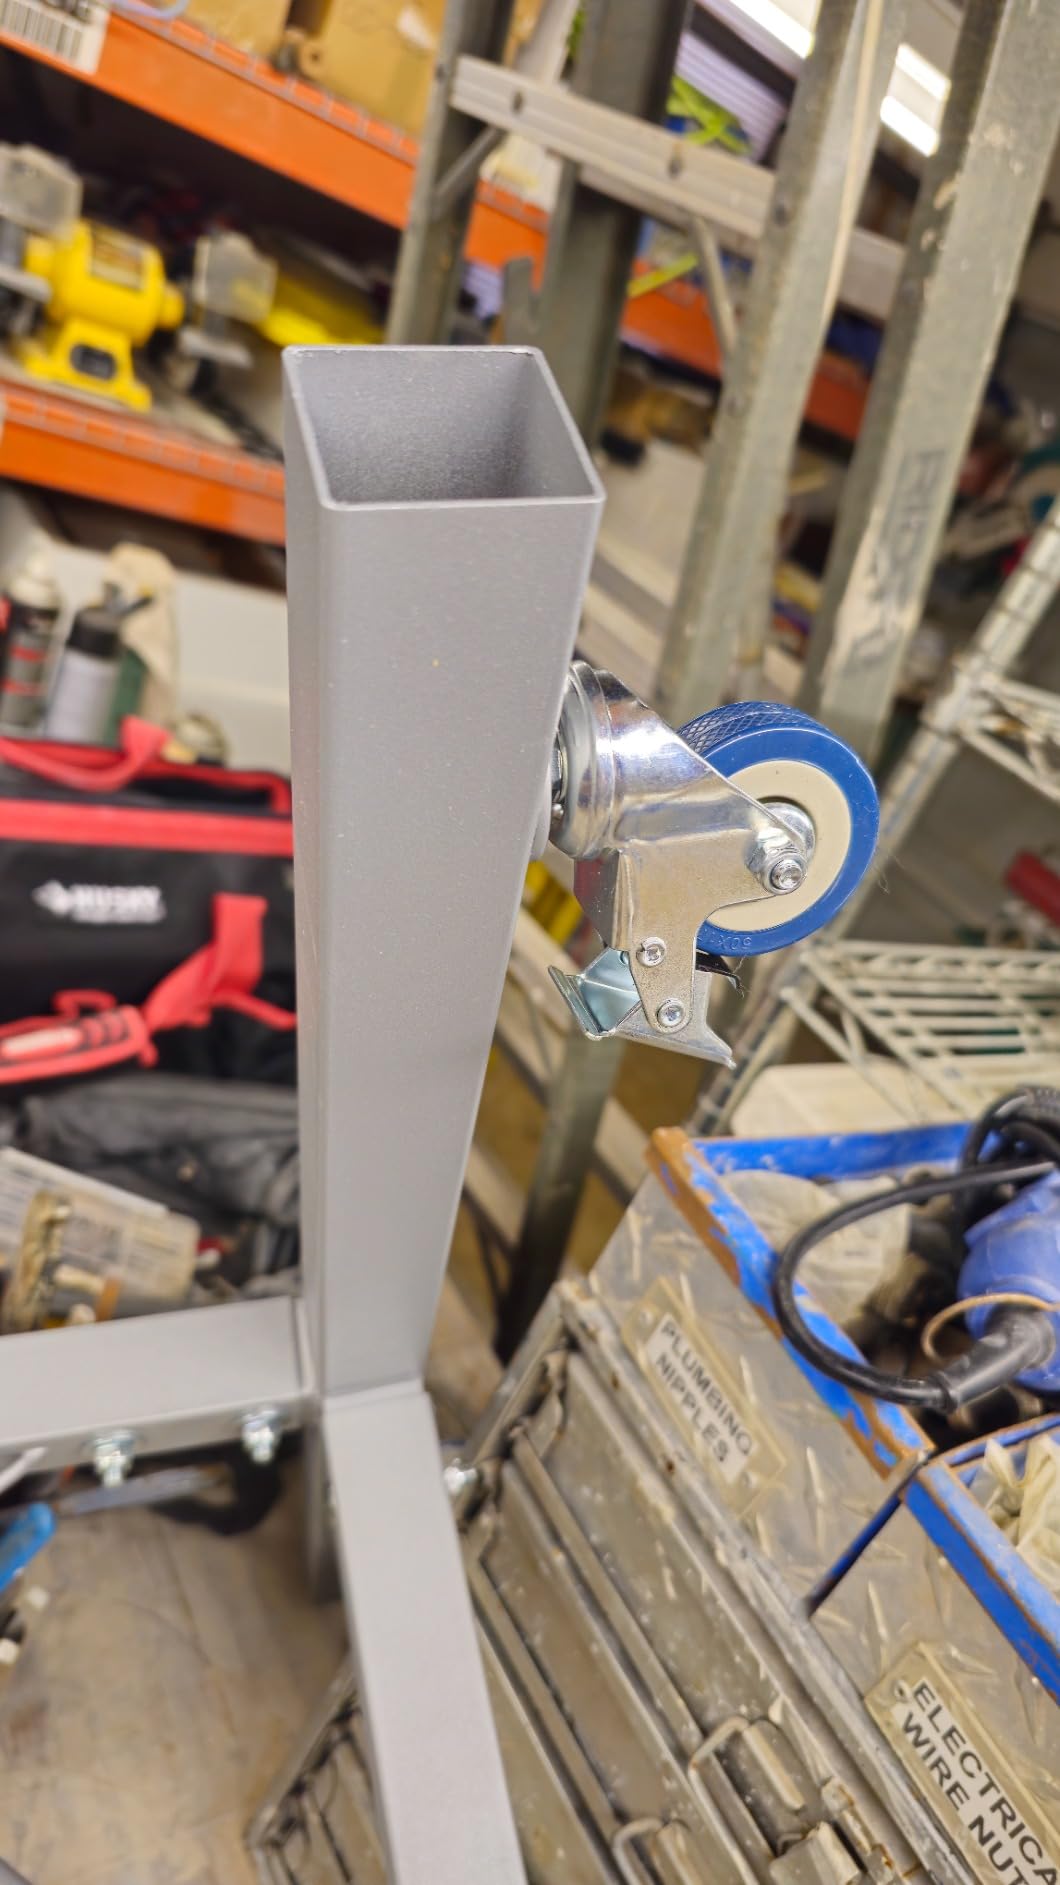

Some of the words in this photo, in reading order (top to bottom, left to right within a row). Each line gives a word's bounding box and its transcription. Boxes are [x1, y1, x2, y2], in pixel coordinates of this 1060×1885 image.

[655, 1353, 728, 1462] NIPPLES
[661, 1321, 751, 1455] PLUMBING
[903, 1712, 970, 1811] WIRE
